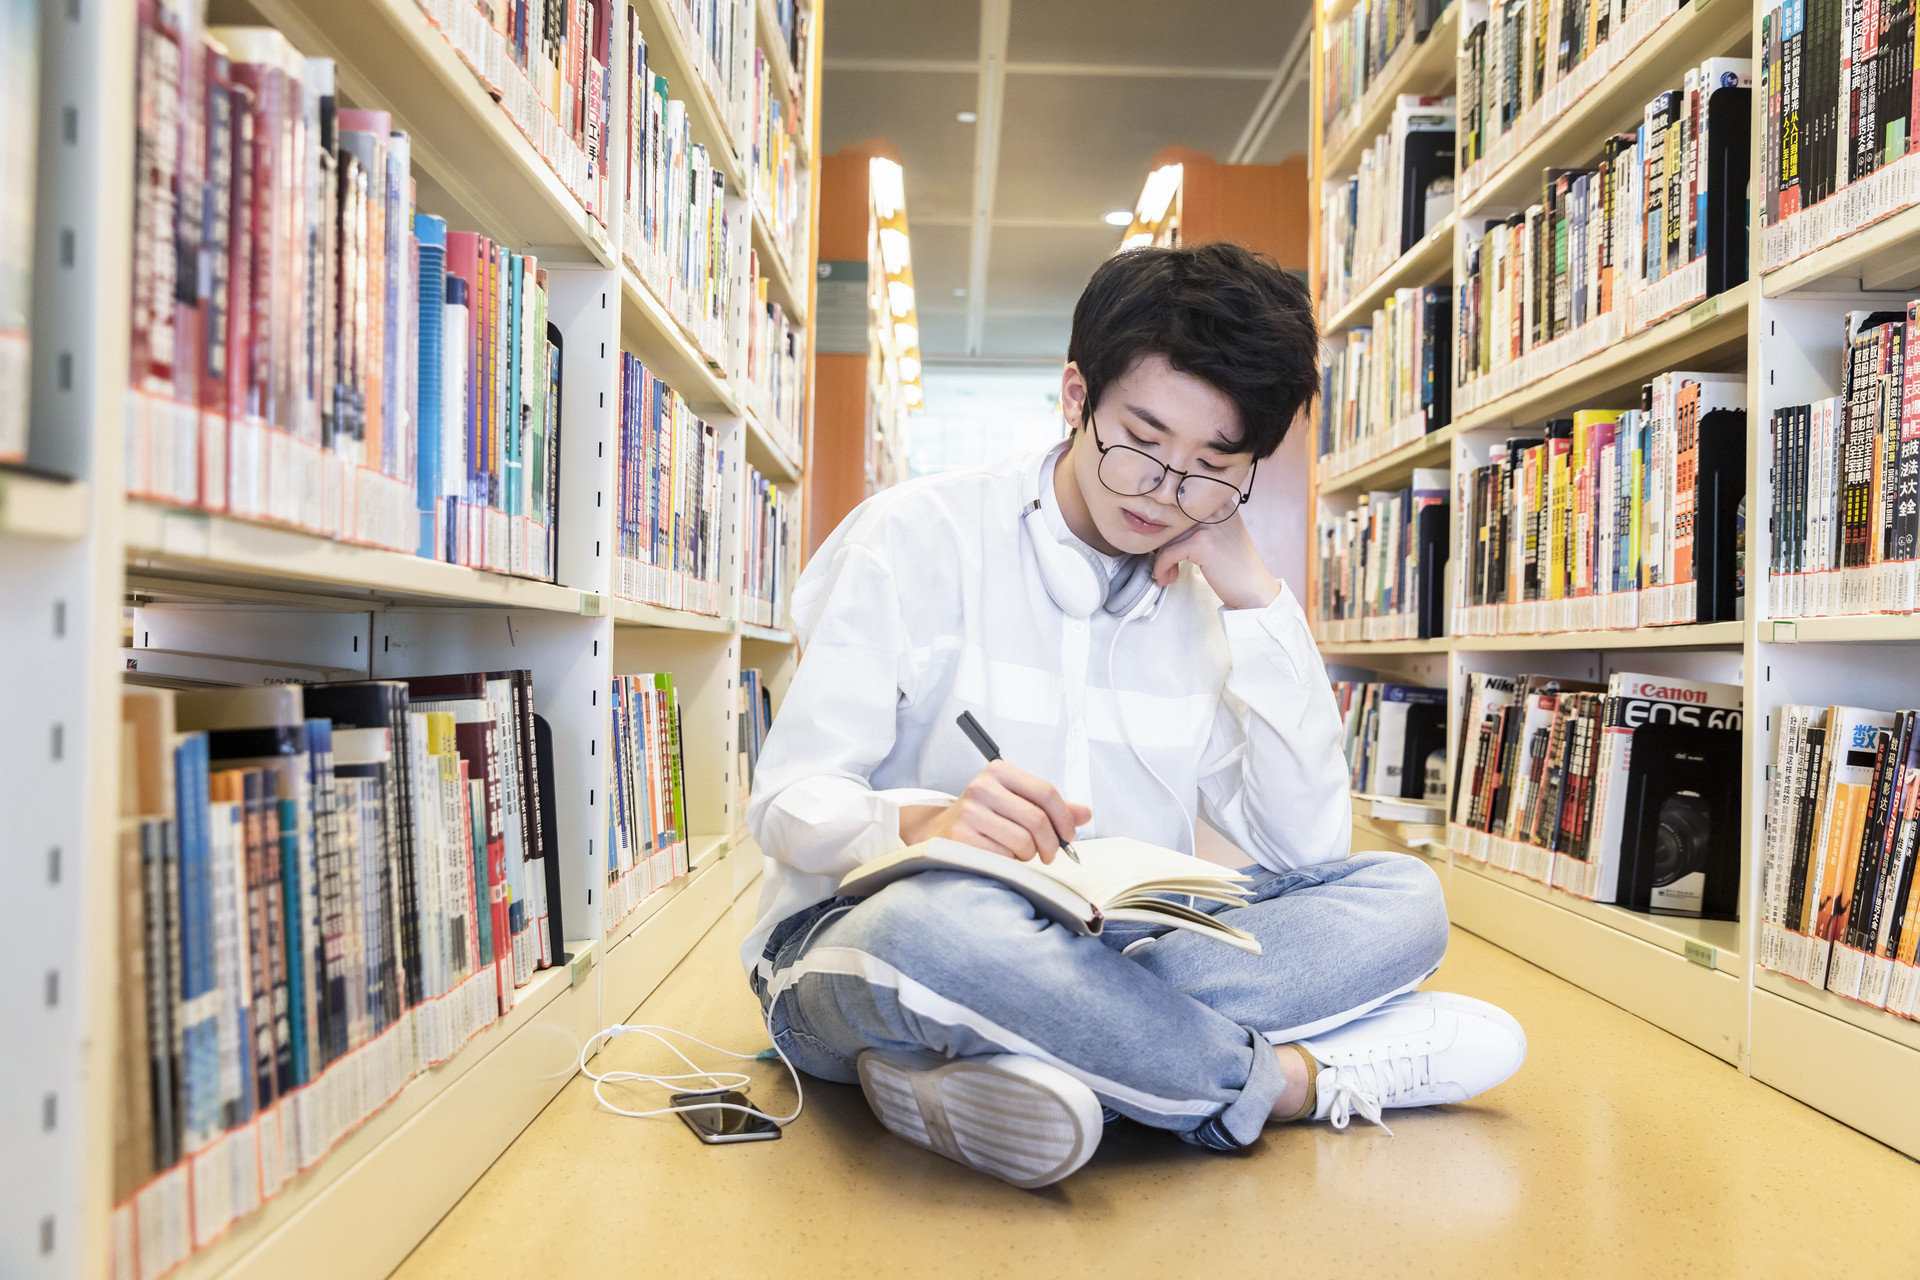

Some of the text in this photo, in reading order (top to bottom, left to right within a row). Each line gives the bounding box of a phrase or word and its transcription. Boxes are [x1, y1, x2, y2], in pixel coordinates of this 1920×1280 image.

[1870, 13, 1879, 31] 6D
[1640, 683, 1708, 704] Canon
[1624, 700, 1701, 728] EOS
[1877, 737, 1899, 826] 数码摄影达人
